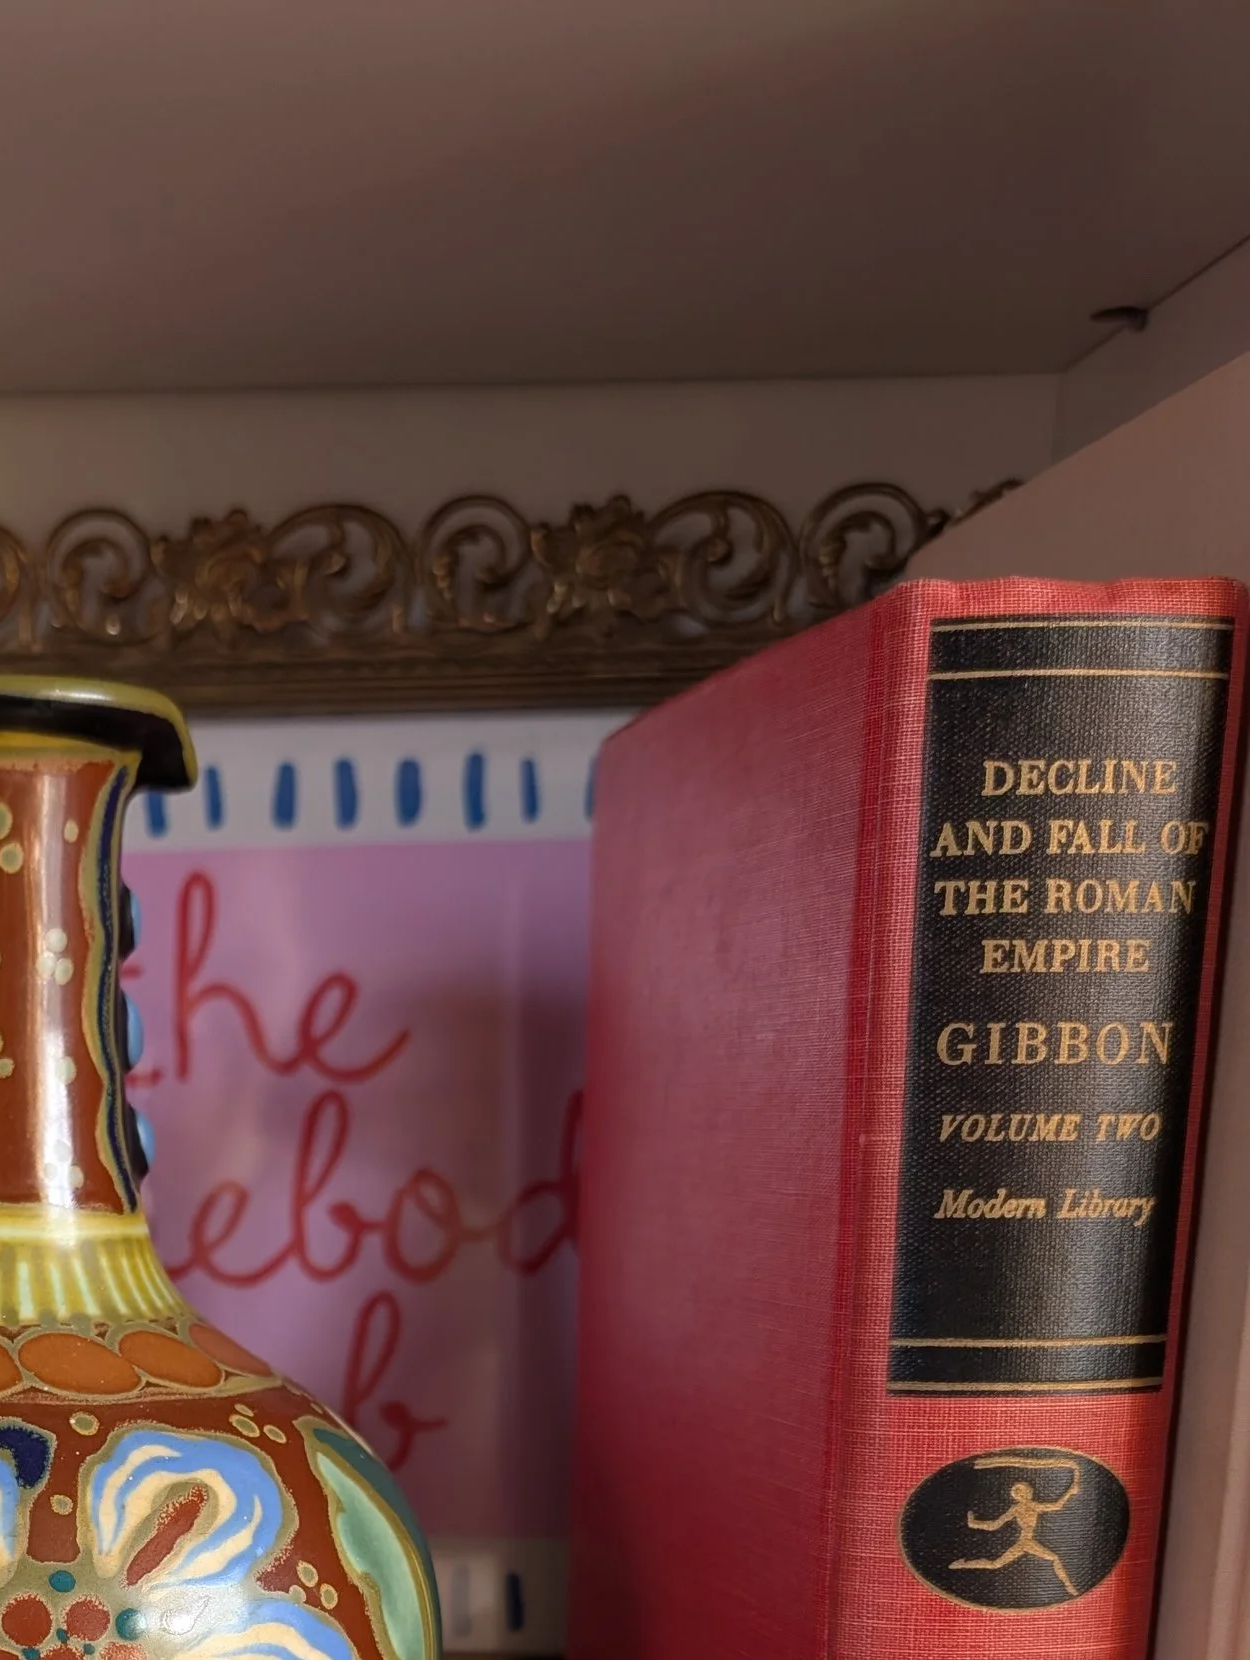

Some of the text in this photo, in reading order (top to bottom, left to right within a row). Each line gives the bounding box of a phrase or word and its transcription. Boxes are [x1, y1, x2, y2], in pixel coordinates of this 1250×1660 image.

[982, 759, 1177, 797] DECLINE
[930, 819, 1210, 858] AND FALL OF
[934, 879, 1197, 916] THE ROMAN
[980, 939, 1151, 974] EMPIRE
[122, 870, 410, 1085] he
[936, 1021, 1174, 1066] GIBBON
[938, 1114, 1164, 1143] VOLUME TWO
[934, 1188, 1156, 1228] Modern Library
